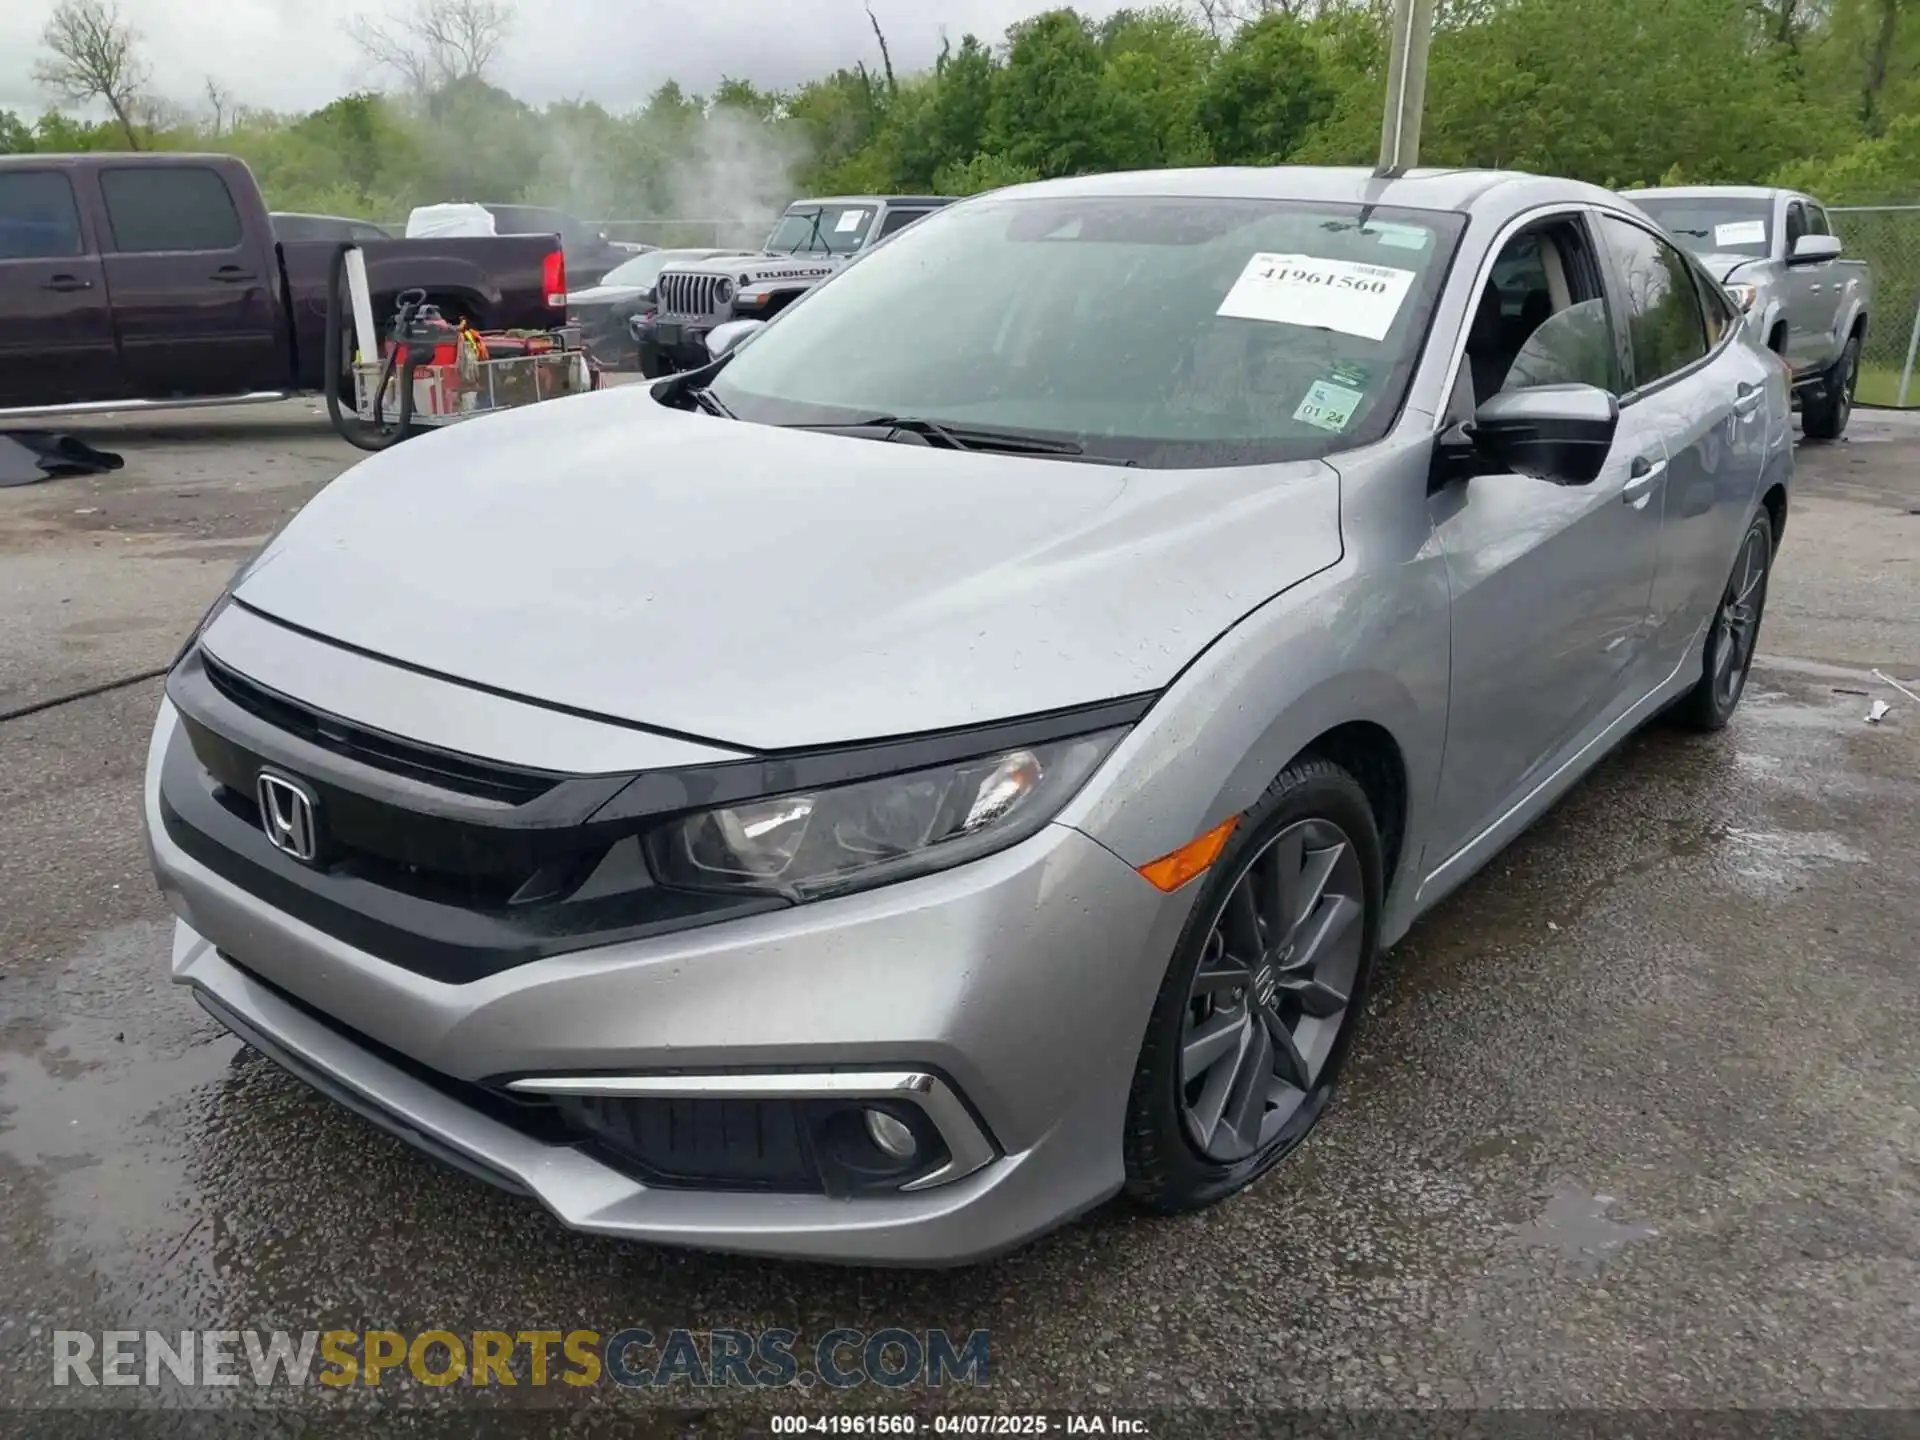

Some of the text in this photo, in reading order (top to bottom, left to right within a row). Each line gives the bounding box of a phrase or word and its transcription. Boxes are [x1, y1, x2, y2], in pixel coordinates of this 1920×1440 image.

[756, 267, 832, 279] RUBICON
[1258, 267, 1387, 295] 41961560
[1303, 403, 1345, 424] 01 24
